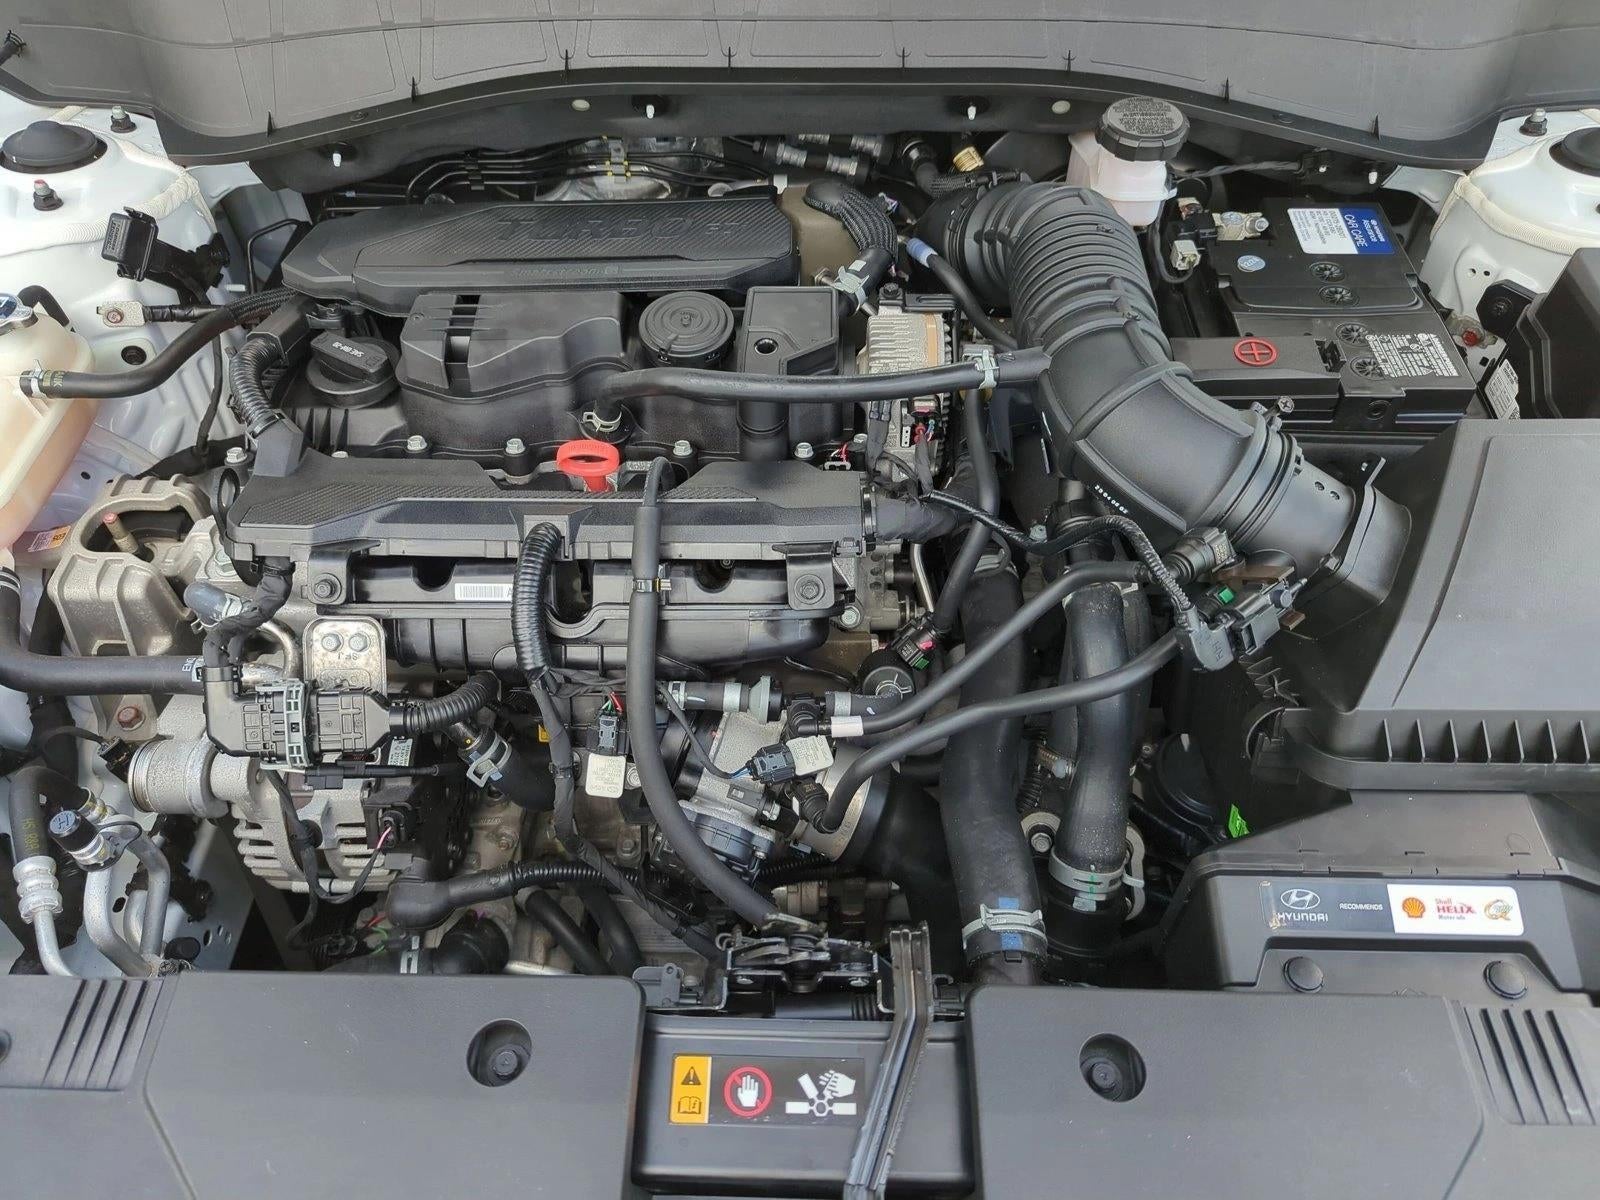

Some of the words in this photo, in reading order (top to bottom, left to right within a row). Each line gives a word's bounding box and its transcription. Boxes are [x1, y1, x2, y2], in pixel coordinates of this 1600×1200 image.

[1344, 214, 1359, 229] CAR
[1351, 229, 1368, 247] CARE
[1339, 903, 1384, 911] RECOMMENDS
[1437, 905, 1474, 914] HELIX
[1278, 912, 1329, 922] HYUNDAI
